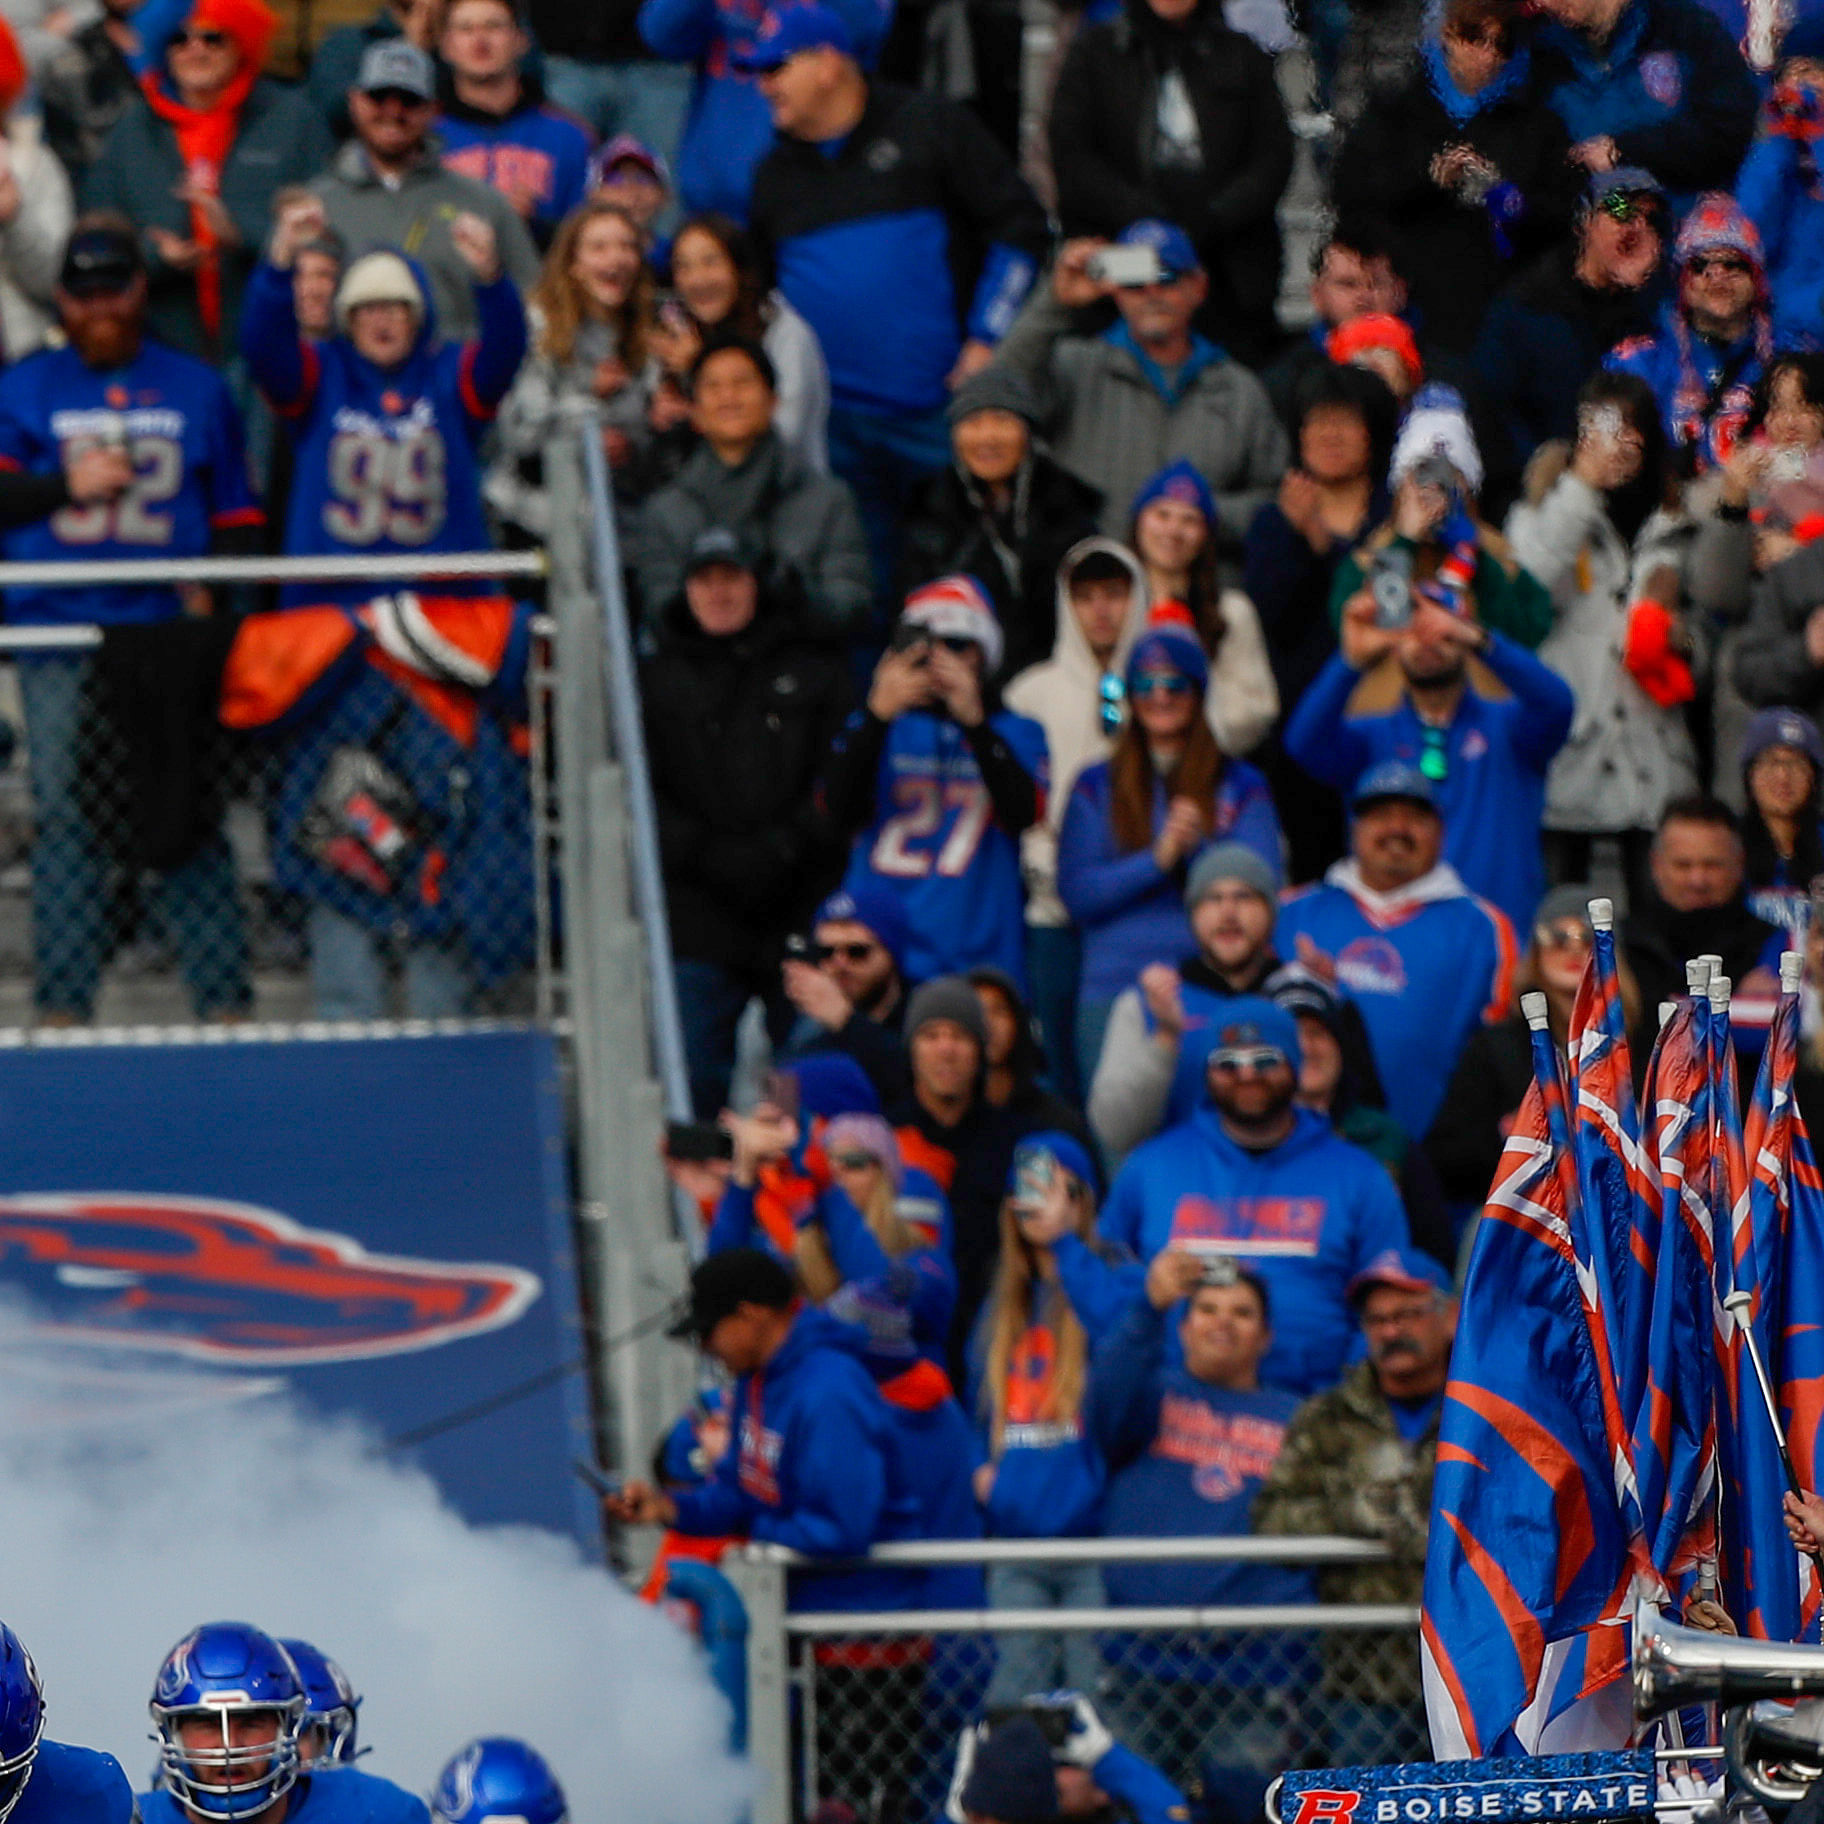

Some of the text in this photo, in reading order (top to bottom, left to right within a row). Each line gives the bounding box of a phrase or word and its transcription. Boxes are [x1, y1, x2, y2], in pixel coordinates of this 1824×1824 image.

[322, 428, 448, 546] 99
[870, 775, 994, 878] 27
[1377, 1792, 1502, 1823] BOISE
[1522, 1784, 1648, 1814] STATE
